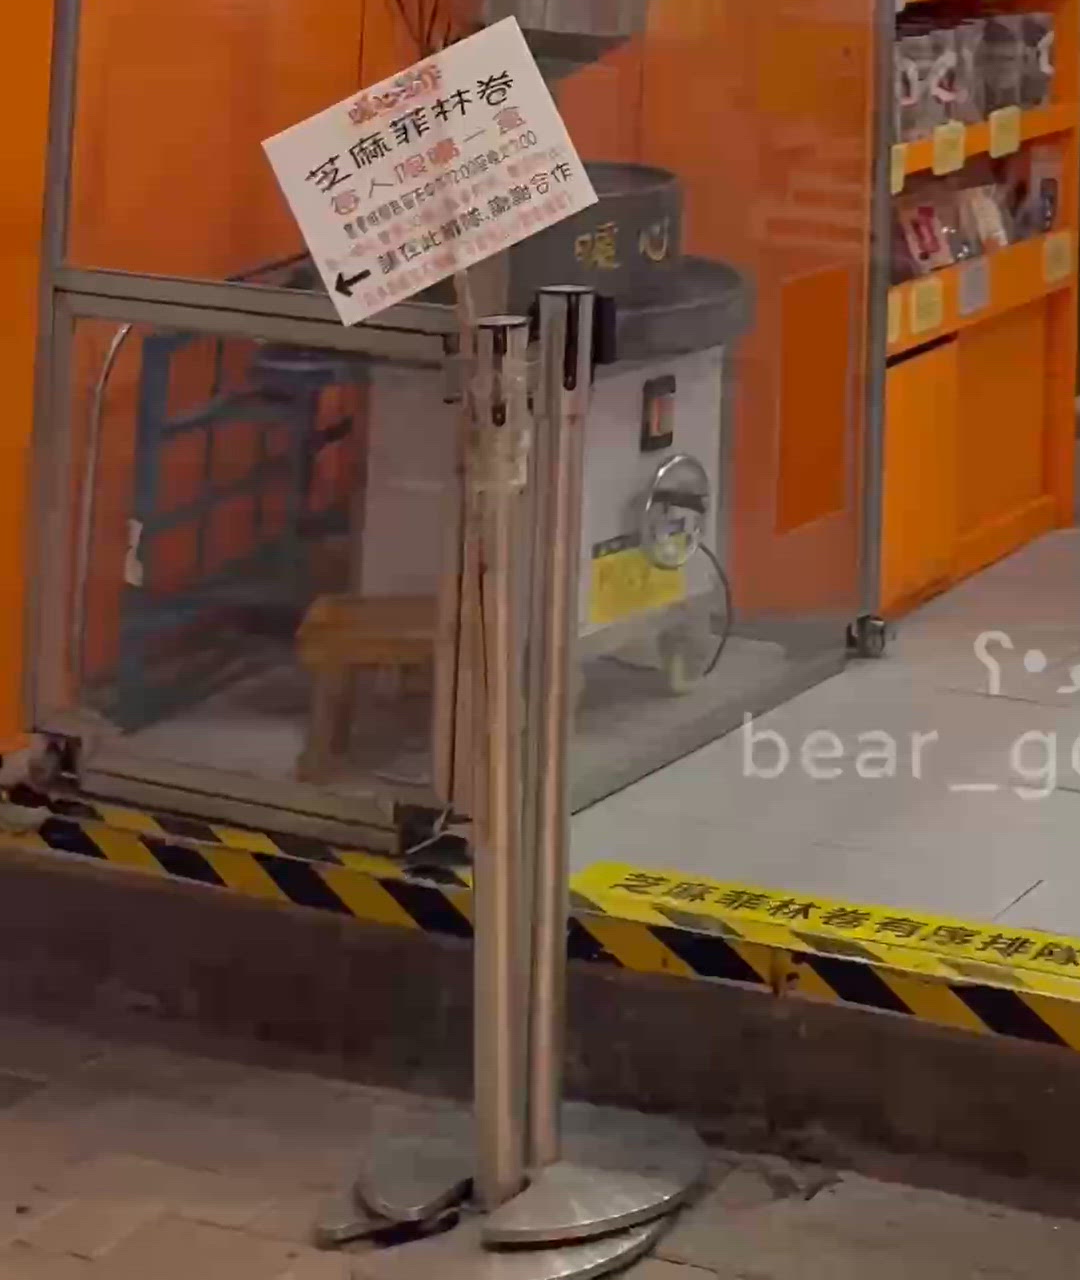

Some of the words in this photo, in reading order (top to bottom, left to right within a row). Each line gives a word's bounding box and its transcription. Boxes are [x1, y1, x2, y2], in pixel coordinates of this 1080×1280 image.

[305, 69, 515, 194] 芝麻菲林卷
